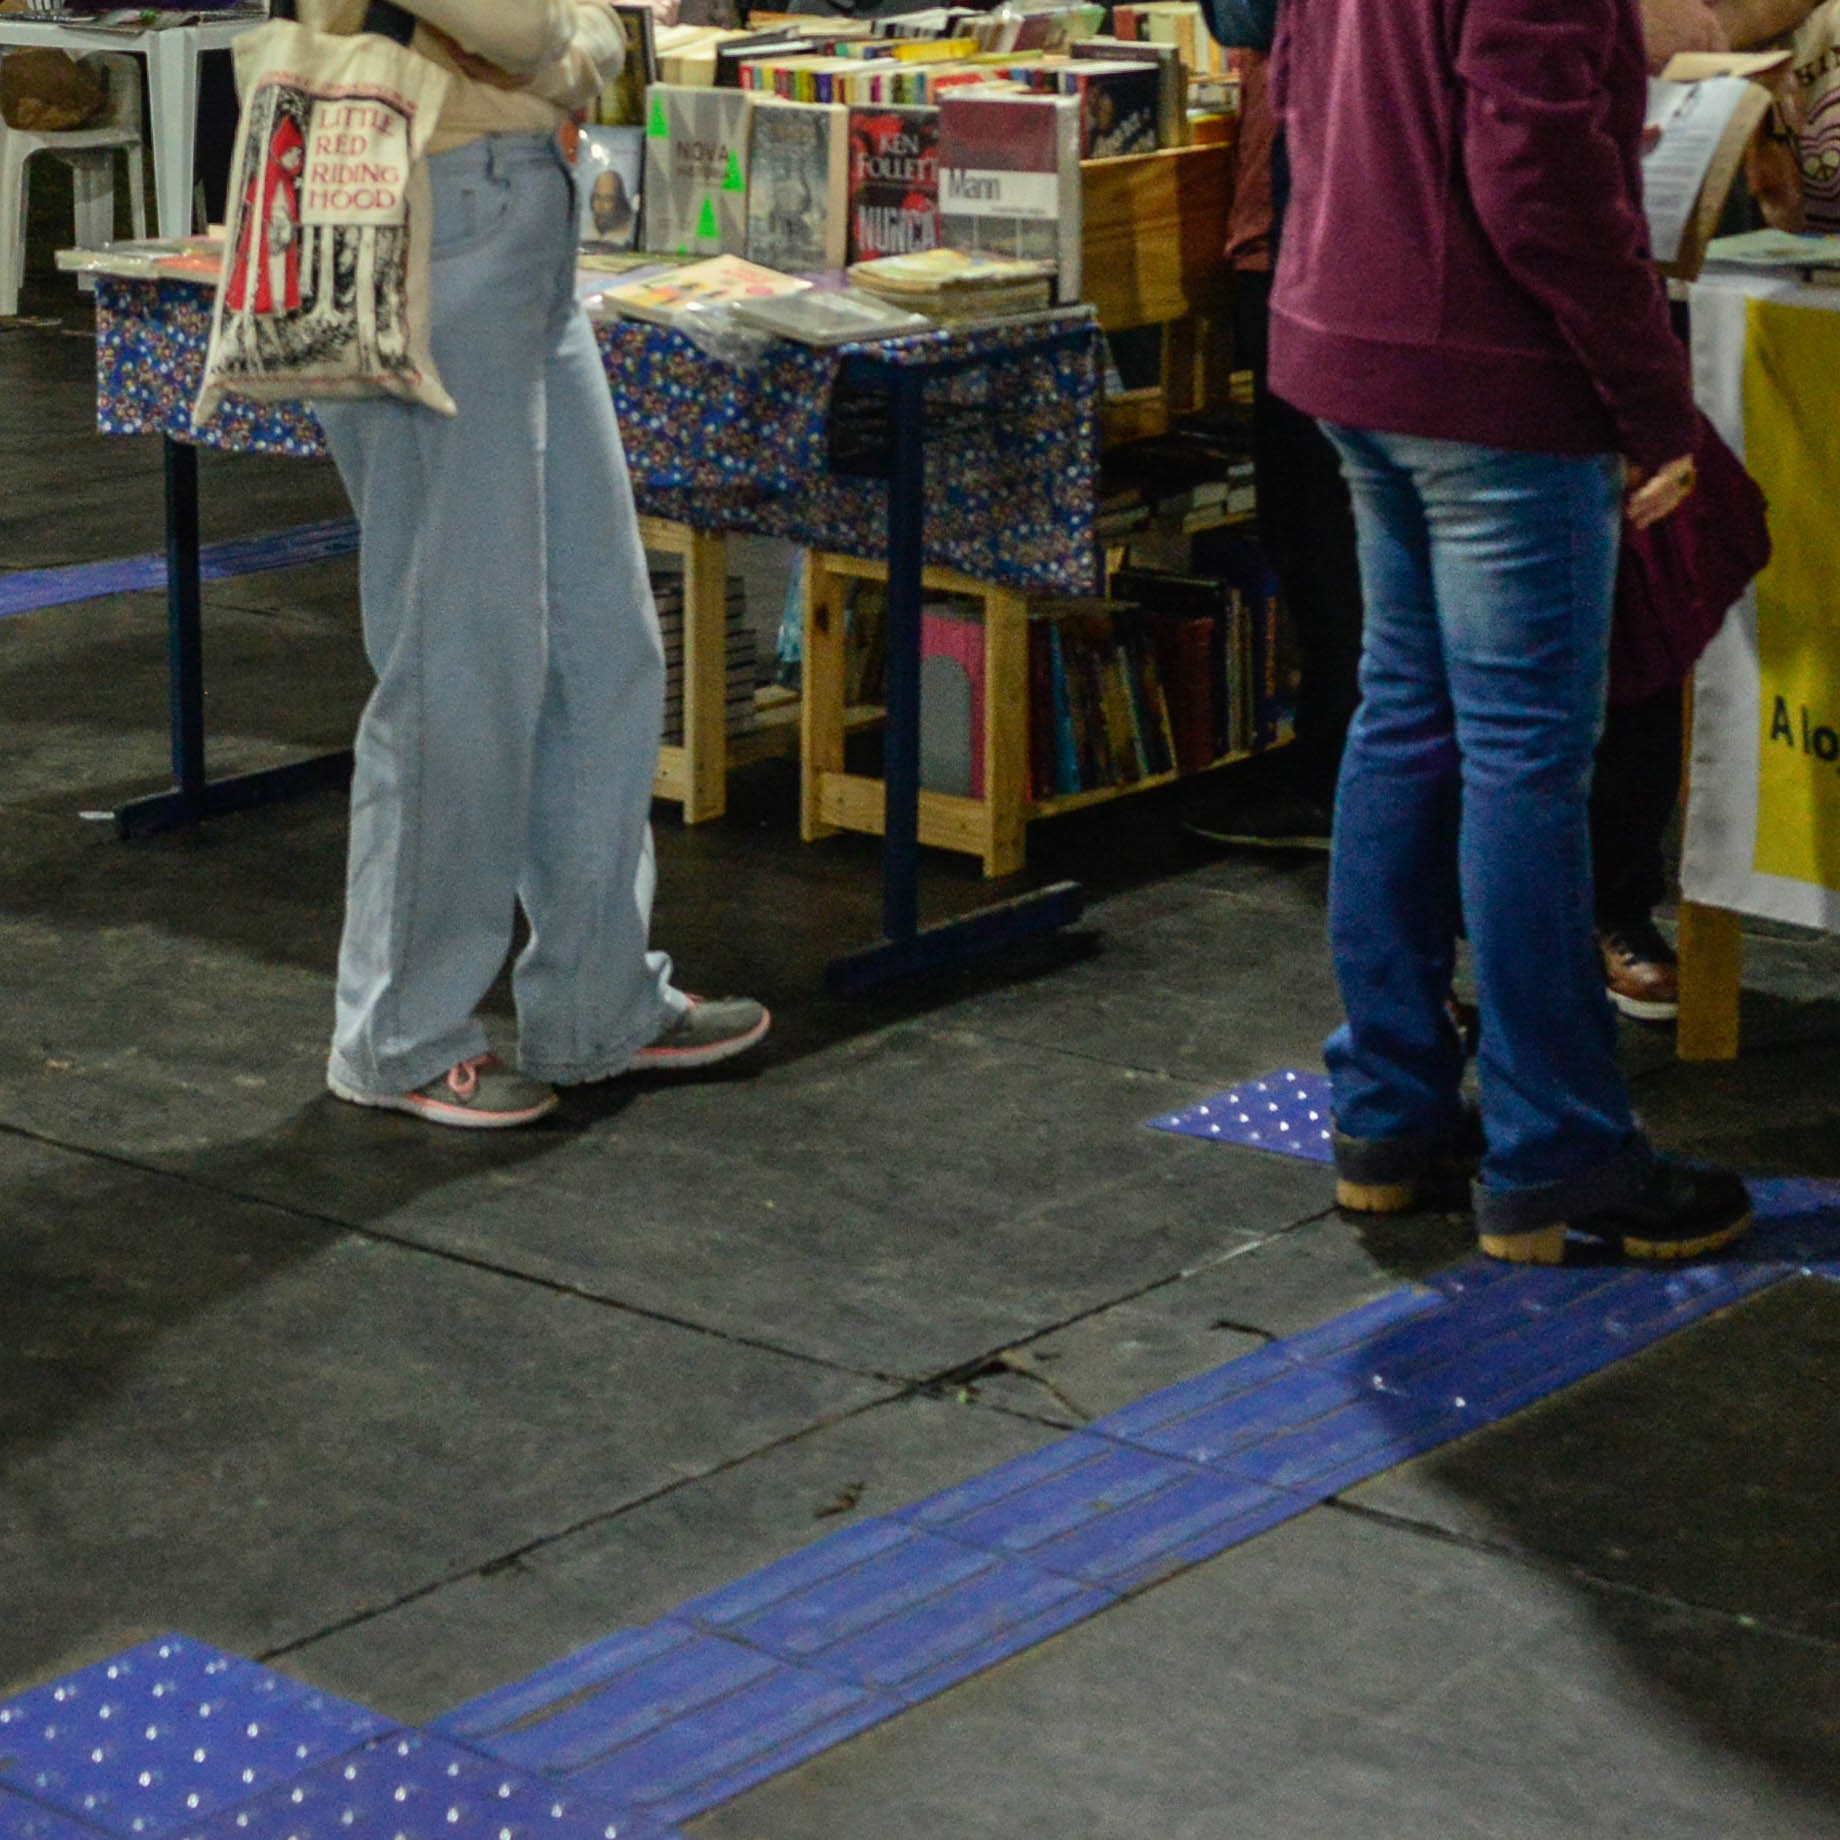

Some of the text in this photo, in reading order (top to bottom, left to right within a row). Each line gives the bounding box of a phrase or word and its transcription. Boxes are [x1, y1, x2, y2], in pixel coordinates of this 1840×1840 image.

[319, 104, 395, 137] LITTLE
[315, 132, 368, 157] RED
[879, 131, 919, 155] KEN
[310, 162, 401, 185] RIDING
[947, 167, 1001, 201] Mann
[308, 188, 397, 211] HOOD
[1770, 695, 1795, 749] A
